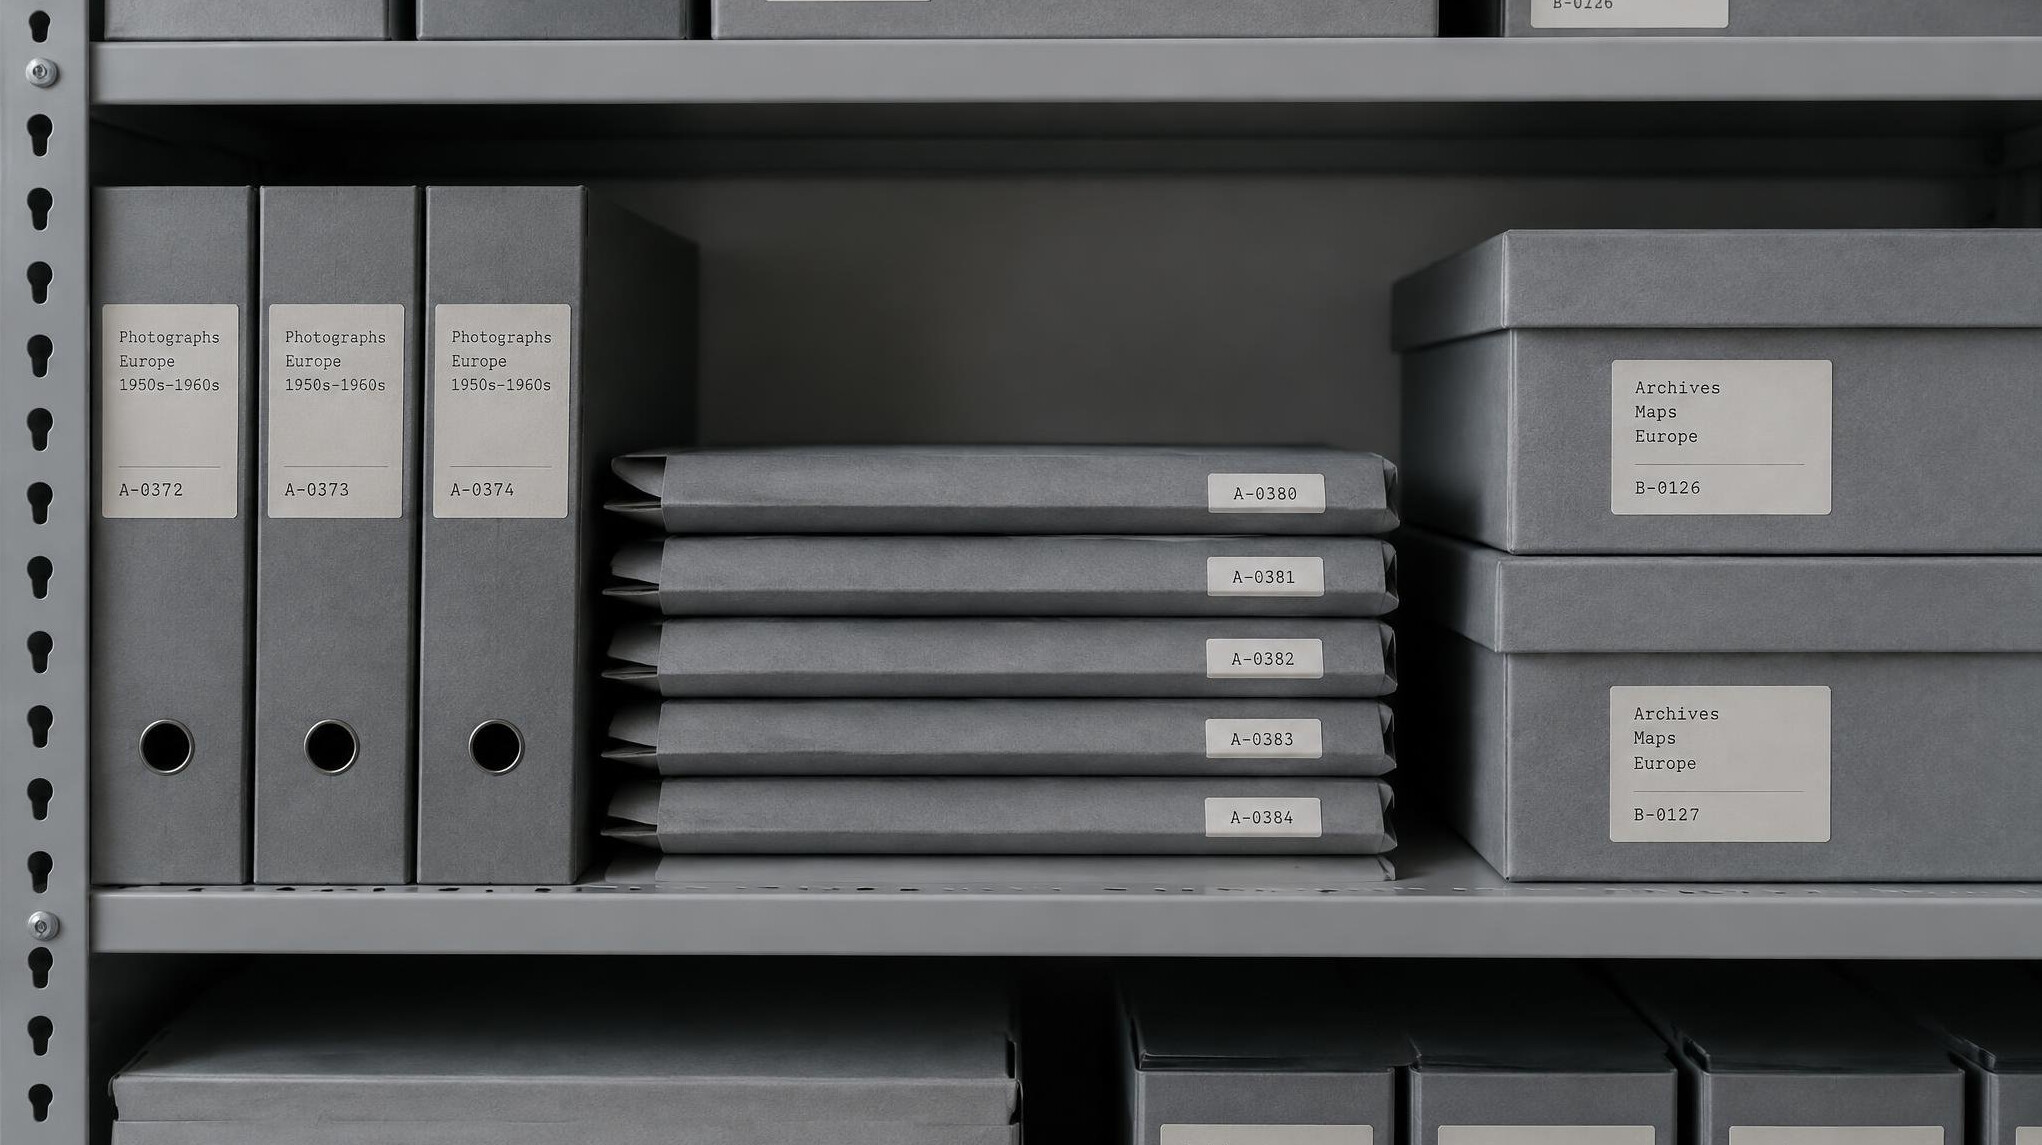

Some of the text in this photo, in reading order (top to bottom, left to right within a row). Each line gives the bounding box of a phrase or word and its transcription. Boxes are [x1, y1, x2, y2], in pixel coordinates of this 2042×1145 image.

[119, 331, 220, 346] Photographs
[286, 330, 385, 346] Photographs
[452, 331, 551, 346] Photographs
[120, 355, 174, 370] Europe
[286, 355, 341, 370] Europe
[452, 355, 506, 370] Europe
[119, 378, 219, 391] 1950s-1960s
[286, 378, 385, 391] 1950s-1960s
[452, 378, 550, 391] 1950s-1960s
[1635, 381, 1720, 394] Archives
[1635, 405, 1676, 421] Maps
[1636, 430, 1698, 446] Europe
[119, 483, 182, 496] A-0372
[285, 483, 348, 496] A-0373
[450, 483, 513, 496] A-0374
[1233, 487, 1297, 500] A-0380
[1635, 480, 1700, 494] B-0126
[1233, 570, 1294, 584] A-0381
[1232, 652, 1294, 665] A-0382
[1634, 707, 1719, 721] Archives
[1231, 732, 1293, 746] A-0383
[1634, 731, 1675, 748] Maps
[1634, 757, 1696, 772] Europe
[1231, 811, 1293, 824] A-0384
[1634, 807, 1699, 821] B-0127
